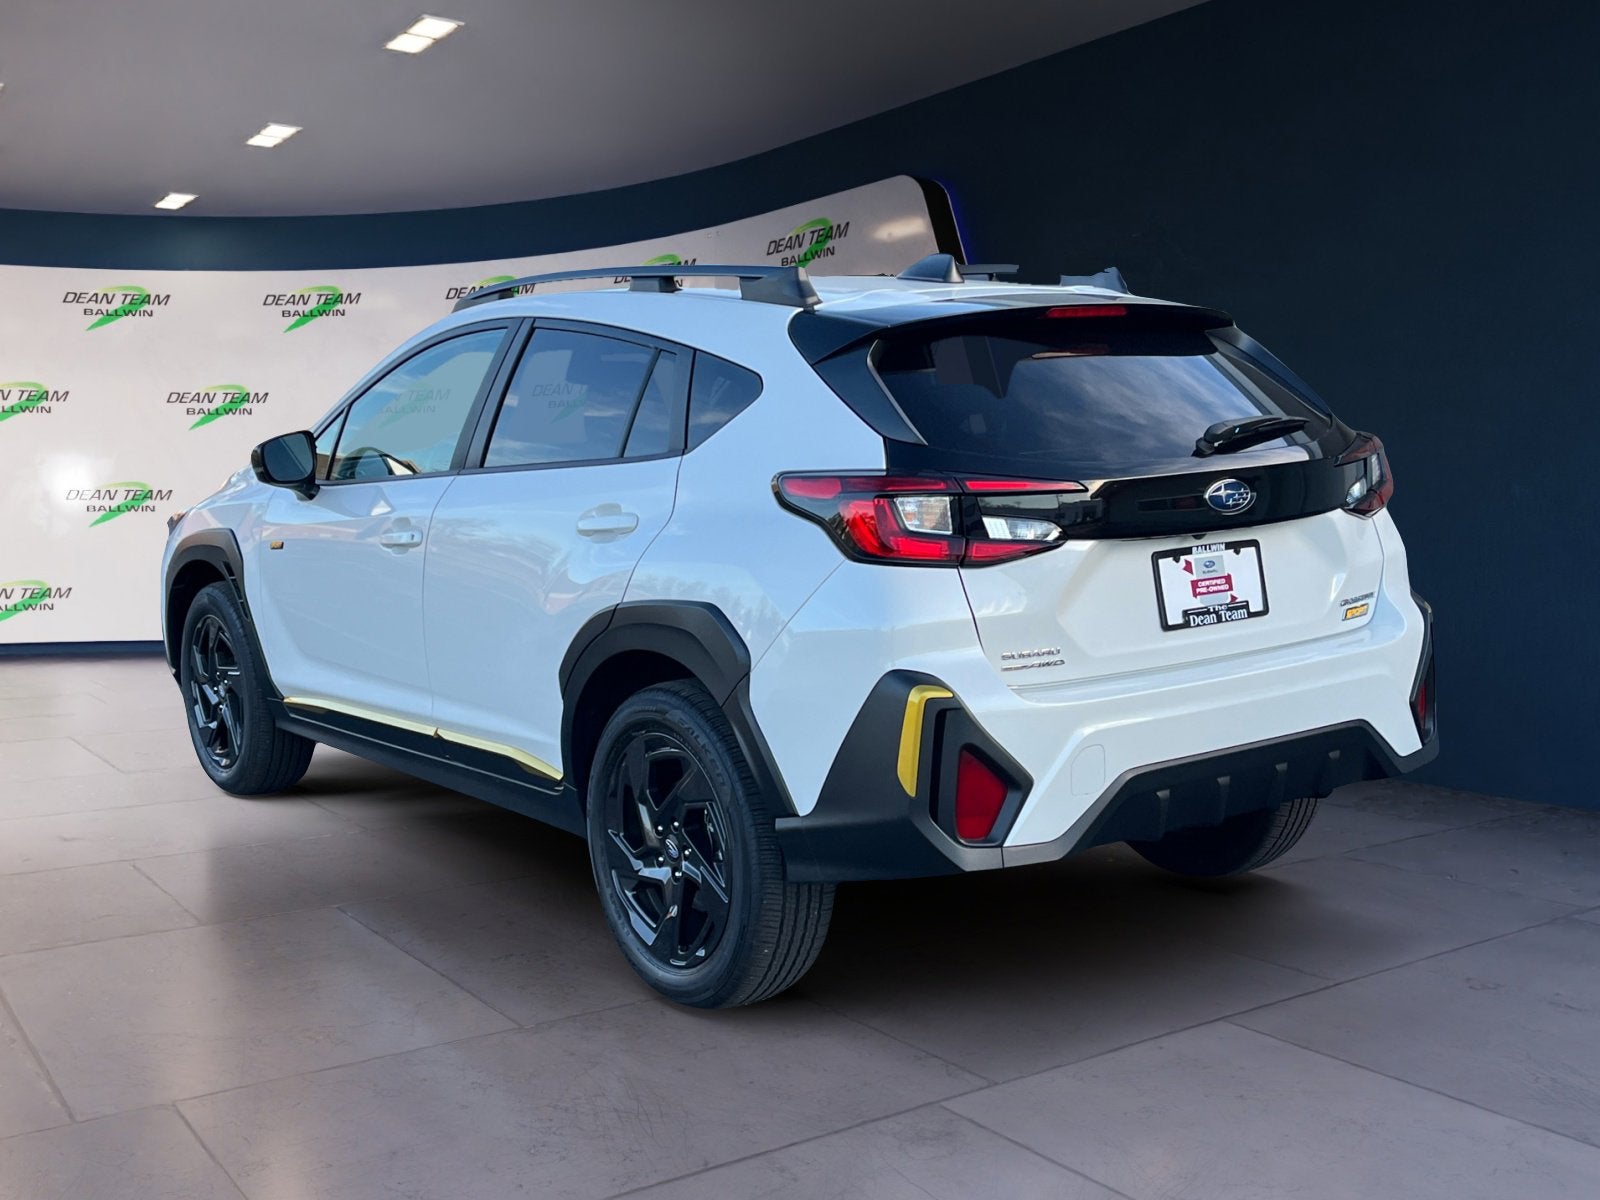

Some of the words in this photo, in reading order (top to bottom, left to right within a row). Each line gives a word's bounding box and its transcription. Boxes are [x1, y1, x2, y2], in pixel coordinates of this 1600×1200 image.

[766, 232, 806, 256] DEAN
[809, 221, 850, 246] TEAM
[781, 246, 835, 267] BALLWIN
[62, 291, 116, 304] DEAN
[121, 293, 171, 306] TEAM
[262, 294, 311, 306] DEAN
[316, 292, 362, 305] TEAM
[83, 308, 154, 317] BALLWIN
[281, 309, 346, 318] BALLWIN
[18, 389, 70, 402] TEAM
[166, 392, 217, 404] DEAN
[222, 392, 269, 404] TEAM
[1, 405, 52, 414] LLWIN
[186, 408, 253, 416] BALLWIN
[66, 489, 118, 501] DEAN
[123, 489, 174, 501] TEAM
[86, 504, 156, 513] BALLWIN
[1192, 543, 1226, 554] BALLWIN
[1198, 578, 1225, 587] CERTIFIED
[21, 586, 73, 600] TEAM
[1196, 584, 1229, 594] PRE-OWNED
[0, 603, 54, 612] LLWIN
[1208, 604, 1227, 612] The
[1189, 613, 1217, 627] Dean
[1219, 608, 1248, 622] Team
[1001, 646, 1061, 661] SUBARU
